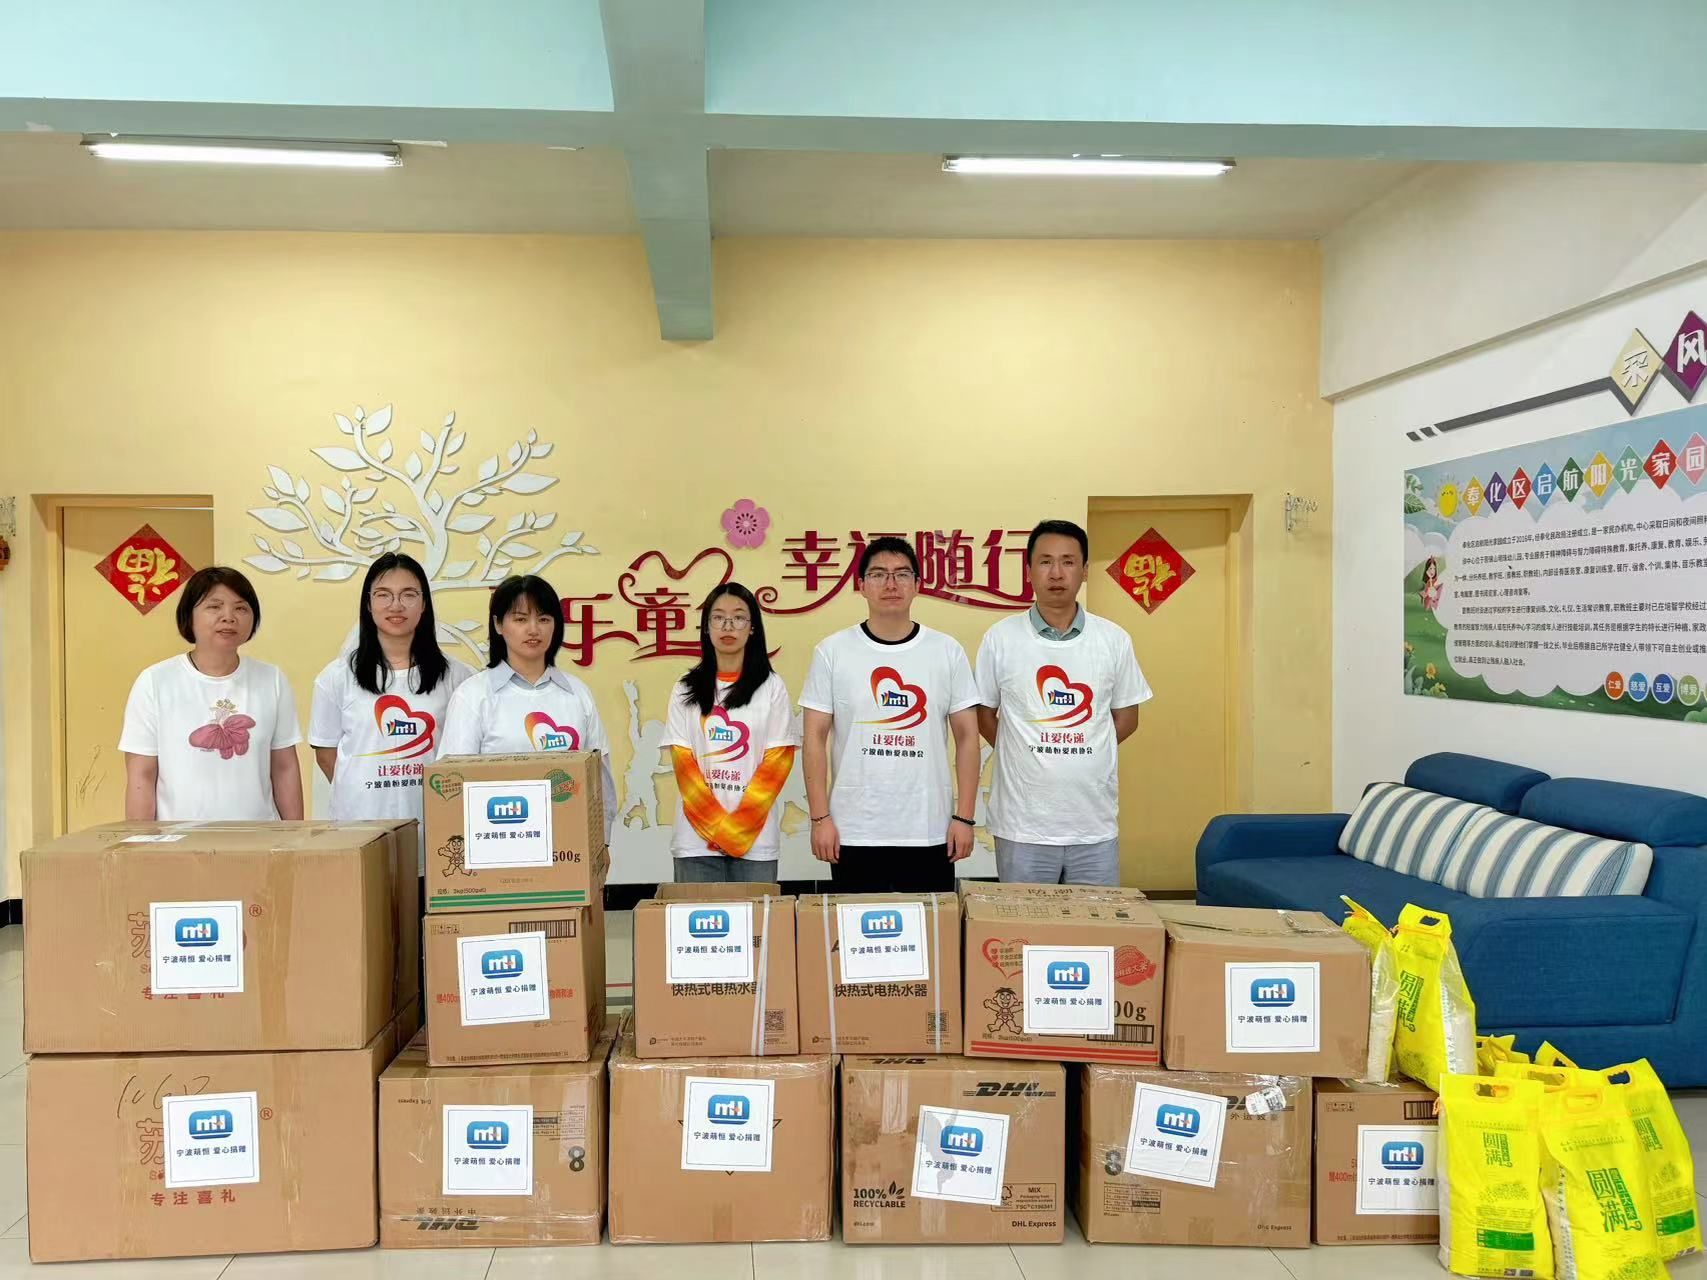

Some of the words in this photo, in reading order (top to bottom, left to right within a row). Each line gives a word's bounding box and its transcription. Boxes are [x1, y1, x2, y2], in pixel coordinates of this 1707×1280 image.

[1467, 445, 1704, 506] 奉化区启航阳光家园
[1123, 552, 1177, 608] 福
[1655, 682, 1671, 693] 互爱
[1680, 682, 1697, 695] 博爱
[872, 733, 916, 746] 让爱传递
[1040, 732, 1085, 744] 让爱传递
[475, 832, 506, 840] 宁波萌恒
[510, 831, 540, 839] 爱心捐赠
[677, 946, 708, 954] 宁波萌恒
[711, 945, 742, 954] 爱心捐赠
[850, 946, 882, 955] 宁波萌恒
[885, 944, 916, 953] 爱心捐赠
[163, 955, 196, 964] 宁波萌恒
[198, 954, 232, 963] 爱心捐赠
[470, 988, 502, 996] 宁波萌恒
[505, 984, 536, 993] 爱心捐赠
[833, 983, 928, 997] 快热式电热水器
[1034, 998, 1067, 1006] 宁波萌恒
[1070, 998, 1103, 1006] 爱心捐赠
[1238, 1015, 1271, 1023] 宁波萌恒
[1274, 1015, 1308, 1023] 爱心捐赠
[976, 1082, 1044, 1097] DHL
[694, 1131, 726, 1141] 宁波萌恒
[729, 1133, 761, 1142] 爱心捐赠
[177, 1149, 210, 1157] 宁波萌恒
[213, 1146, 246, 1155] 爱心捐赠
[1140, 1137, 1173, 1151] 宁波萌恒
[1175, 1143, 1208, 1157] 爱心捐赠
[454, 1157, 486, 1165] 宁波萌恒
[489, 1157, 521, 1165] 爱心捐赠
[568, 1146, 585, 1172] 8
[925, 1160, 957, 1171] 宁波萌恒
[960, 1164, 992, 1175] 爱心捐赠
[1369, 1178, 1400, 1186] 宁波萌恒
[1403, 1178, 1435, 1186] 爱心捐赠
[150, 1189, 236, 1207] 专注喜礼
[853, 1189, 886, 1199] 100%
[853, 1200, 905, 1208] RECYCLABLE
[1028, 1220, 1056, 1228] Express
